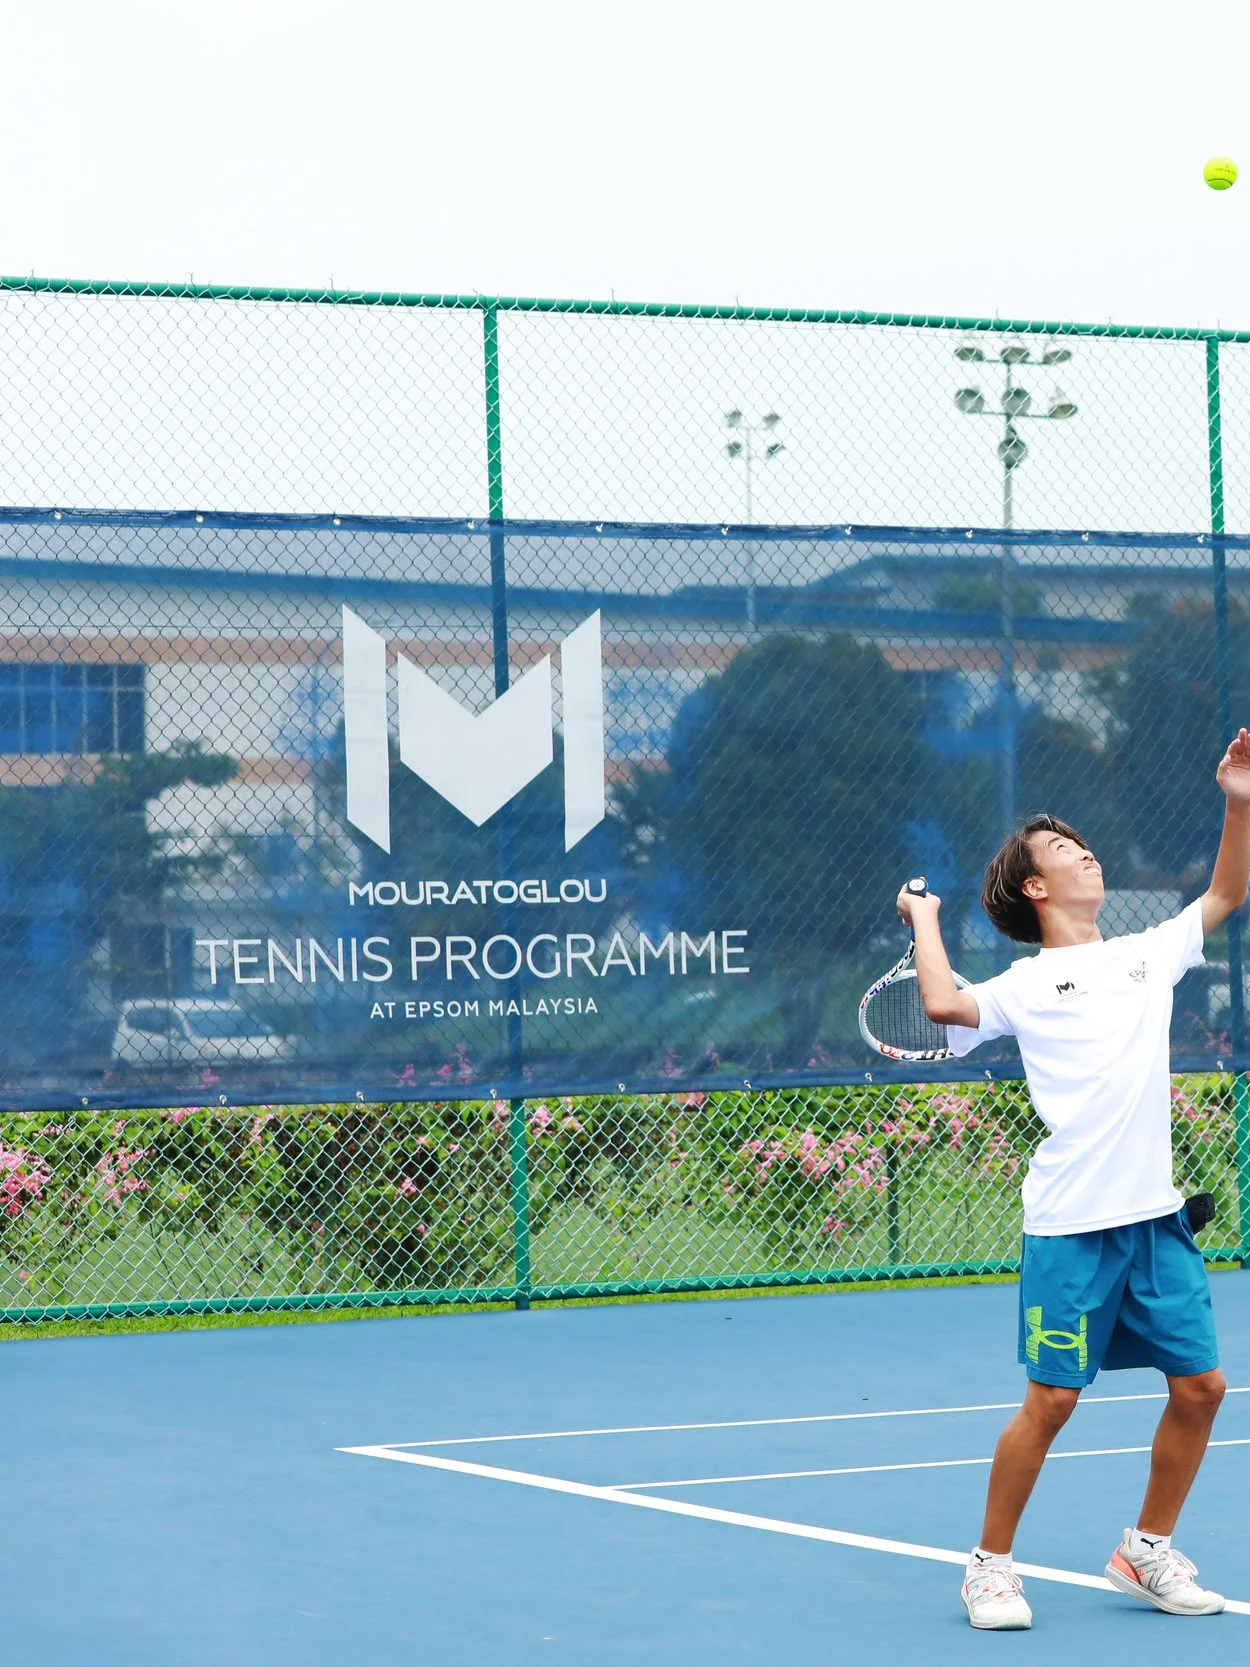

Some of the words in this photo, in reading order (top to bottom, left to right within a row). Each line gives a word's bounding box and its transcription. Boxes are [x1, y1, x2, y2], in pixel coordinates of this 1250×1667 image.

[348, 878, 607, 906] MOURATOGLOU
[195, 936, 393, 985] TENNIS
[410, 930, 751, 981] PROGRAMME
[370, 1002, 396, 1019] AT
[405, 1000, 480, 1019] EPSOM
[489, 997, 599, 1016] MALAYSIA
